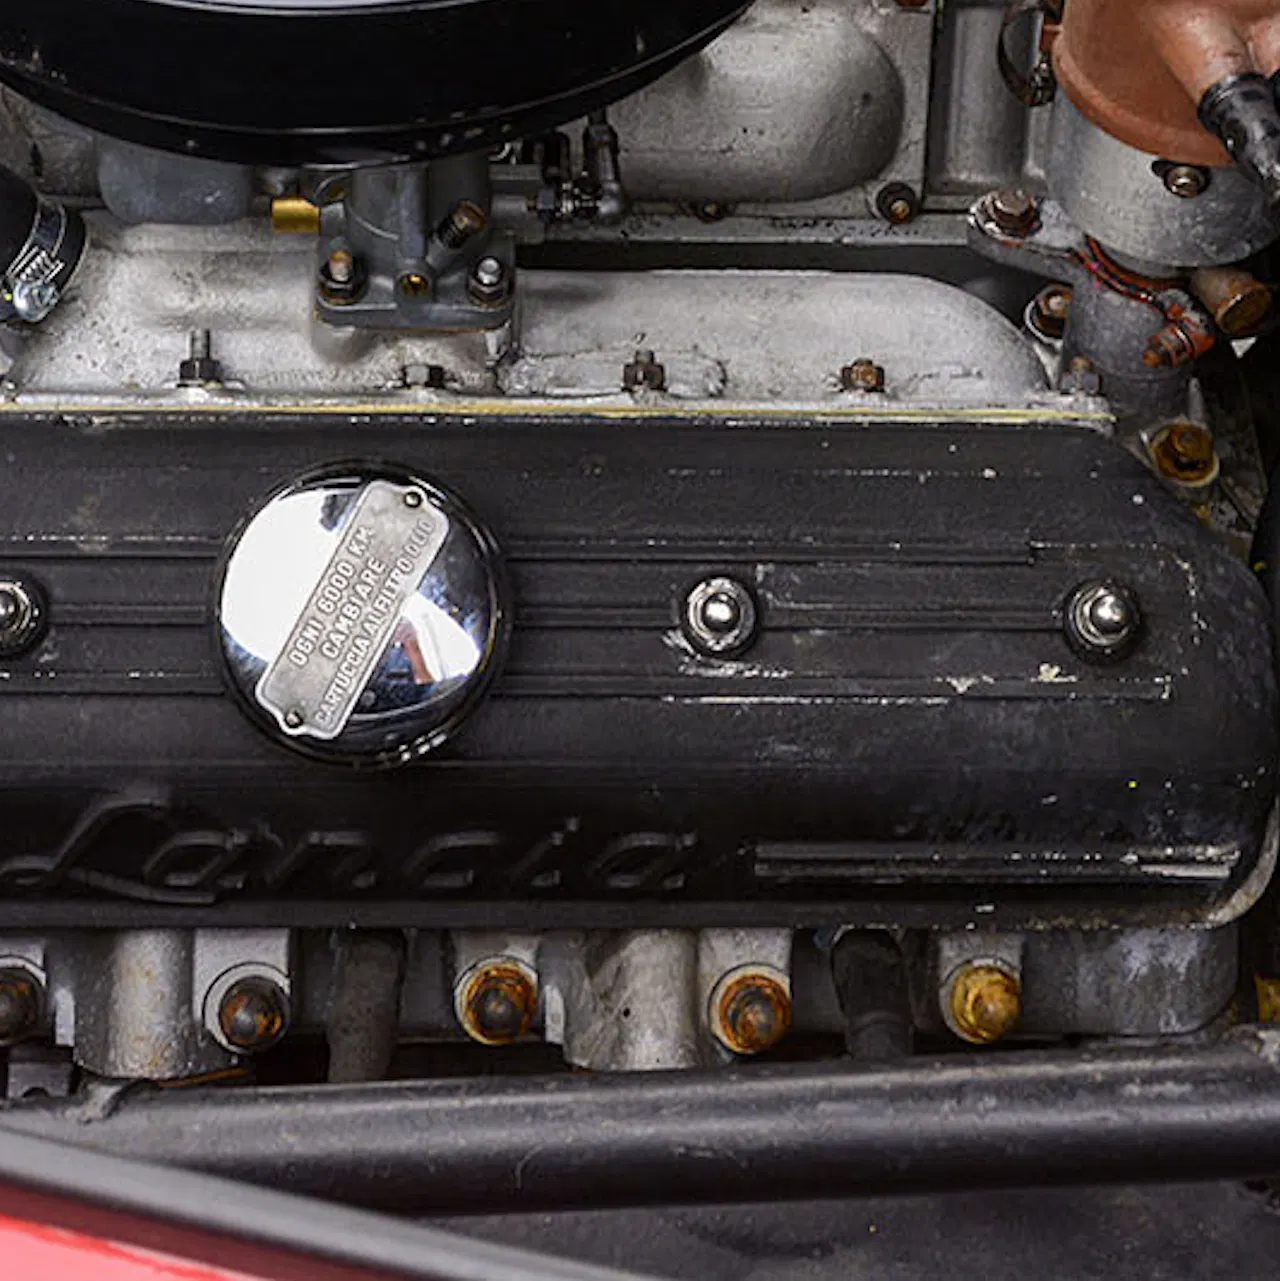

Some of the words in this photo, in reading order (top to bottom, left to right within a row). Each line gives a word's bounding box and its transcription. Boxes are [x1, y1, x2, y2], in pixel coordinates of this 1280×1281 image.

[287, 617, 325, 668] OGNI
[317, 561, 356, 615] 6000
[320, 557, 387, 659] CAMBIARE
[314, 635, 372, 723] CARTUCCIA
